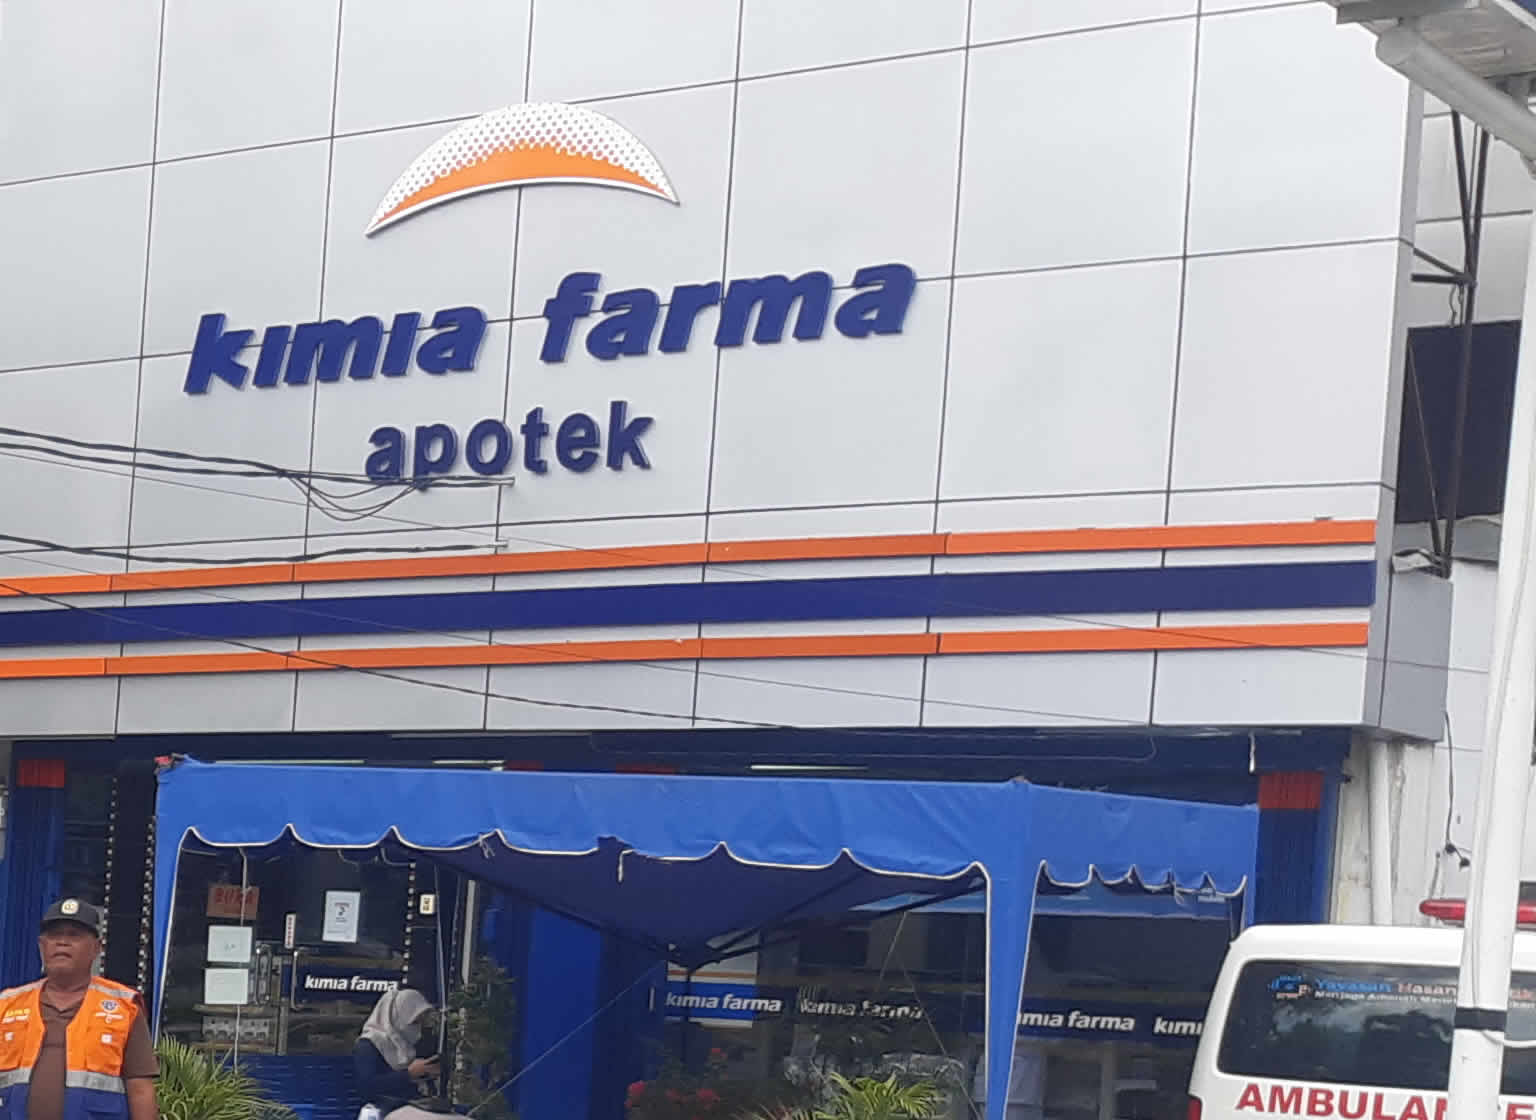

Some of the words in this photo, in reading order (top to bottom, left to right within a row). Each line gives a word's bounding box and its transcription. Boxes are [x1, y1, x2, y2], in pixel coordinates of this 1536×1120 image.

[182, 306, 488, 396] kimia
[538, 262, 918, 364] farma
[364, 401, 654, 492] apotek
[304, 975, 348, 991] kimia
[350, 976, 399, 993] farma
[666, 992, 718, 1009] kimia
[722, 994, 783, 1013] farma
[1068, 1010, 1136, 1032] farma
